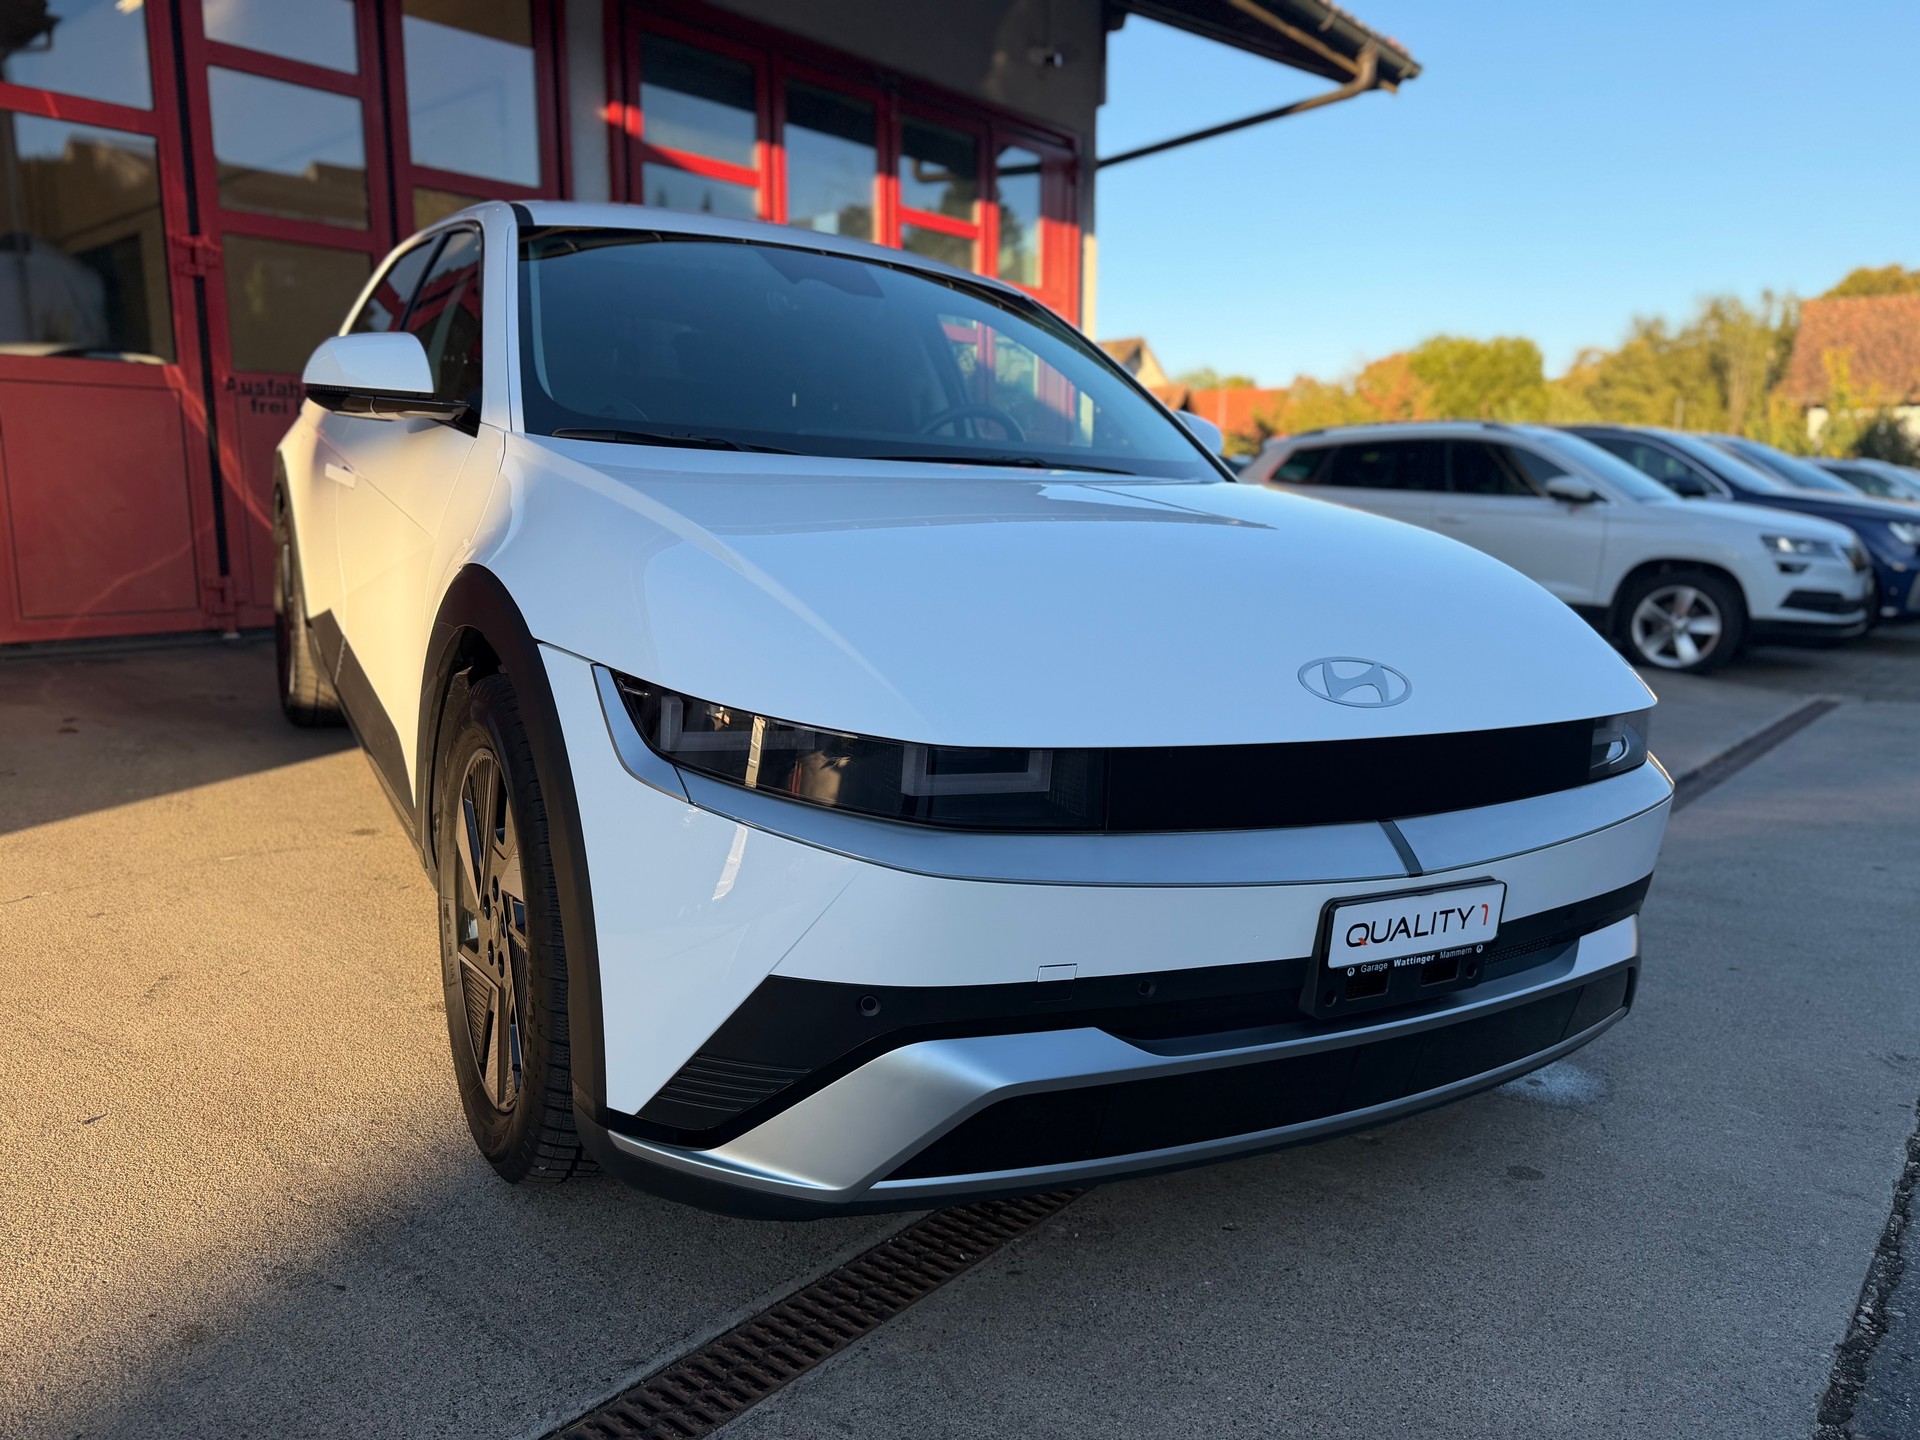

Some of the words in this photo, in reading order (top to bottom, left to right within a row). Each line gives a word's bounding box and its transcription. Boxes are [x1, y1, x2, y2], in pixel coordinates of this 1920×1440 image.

[226, 376, 301, 395] Ausfah
[250, 397, 288, 415] frei
[1345, 905, 1475, 948] QUALITY
[1481, 903, 1489, 926] 1
[1360, 961, 1389, 973] Garage
[1393, 953, 1436, 968] Wattinger
[1439, 946, 1473, 959] Mammern
